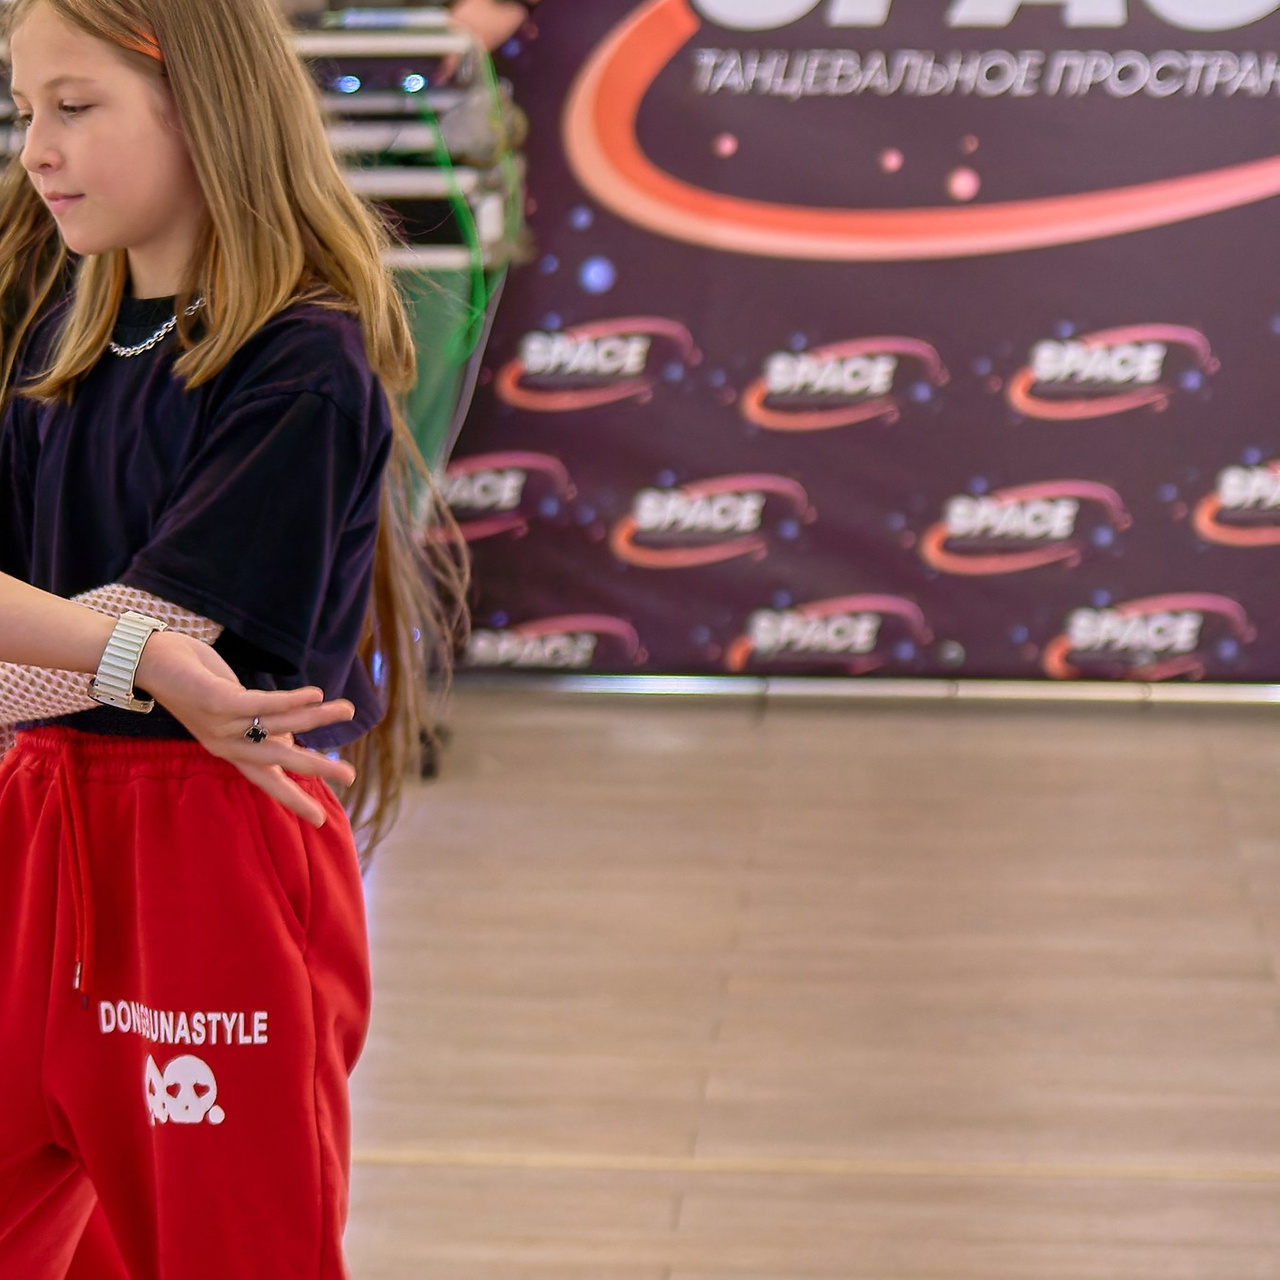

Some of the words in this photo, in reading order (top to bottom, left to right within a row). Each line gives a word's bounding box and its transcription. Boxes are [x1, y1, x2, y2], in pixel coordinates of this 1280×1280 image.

[693, 48, 1046, 102] ТАНЦЕВАЛЬНОЕ
[520, 332, 650, 375] SPACE
[764, 353, 897, 396] SPACE
[1032, 340, 1166, 384] SPACE
[633, 489, 764, 532] SPACE
[944, 496, 1078, 539] SPACE
[749, 610, 880, 653] SPACE
[1068, 608, 1202, 652] SPACE
